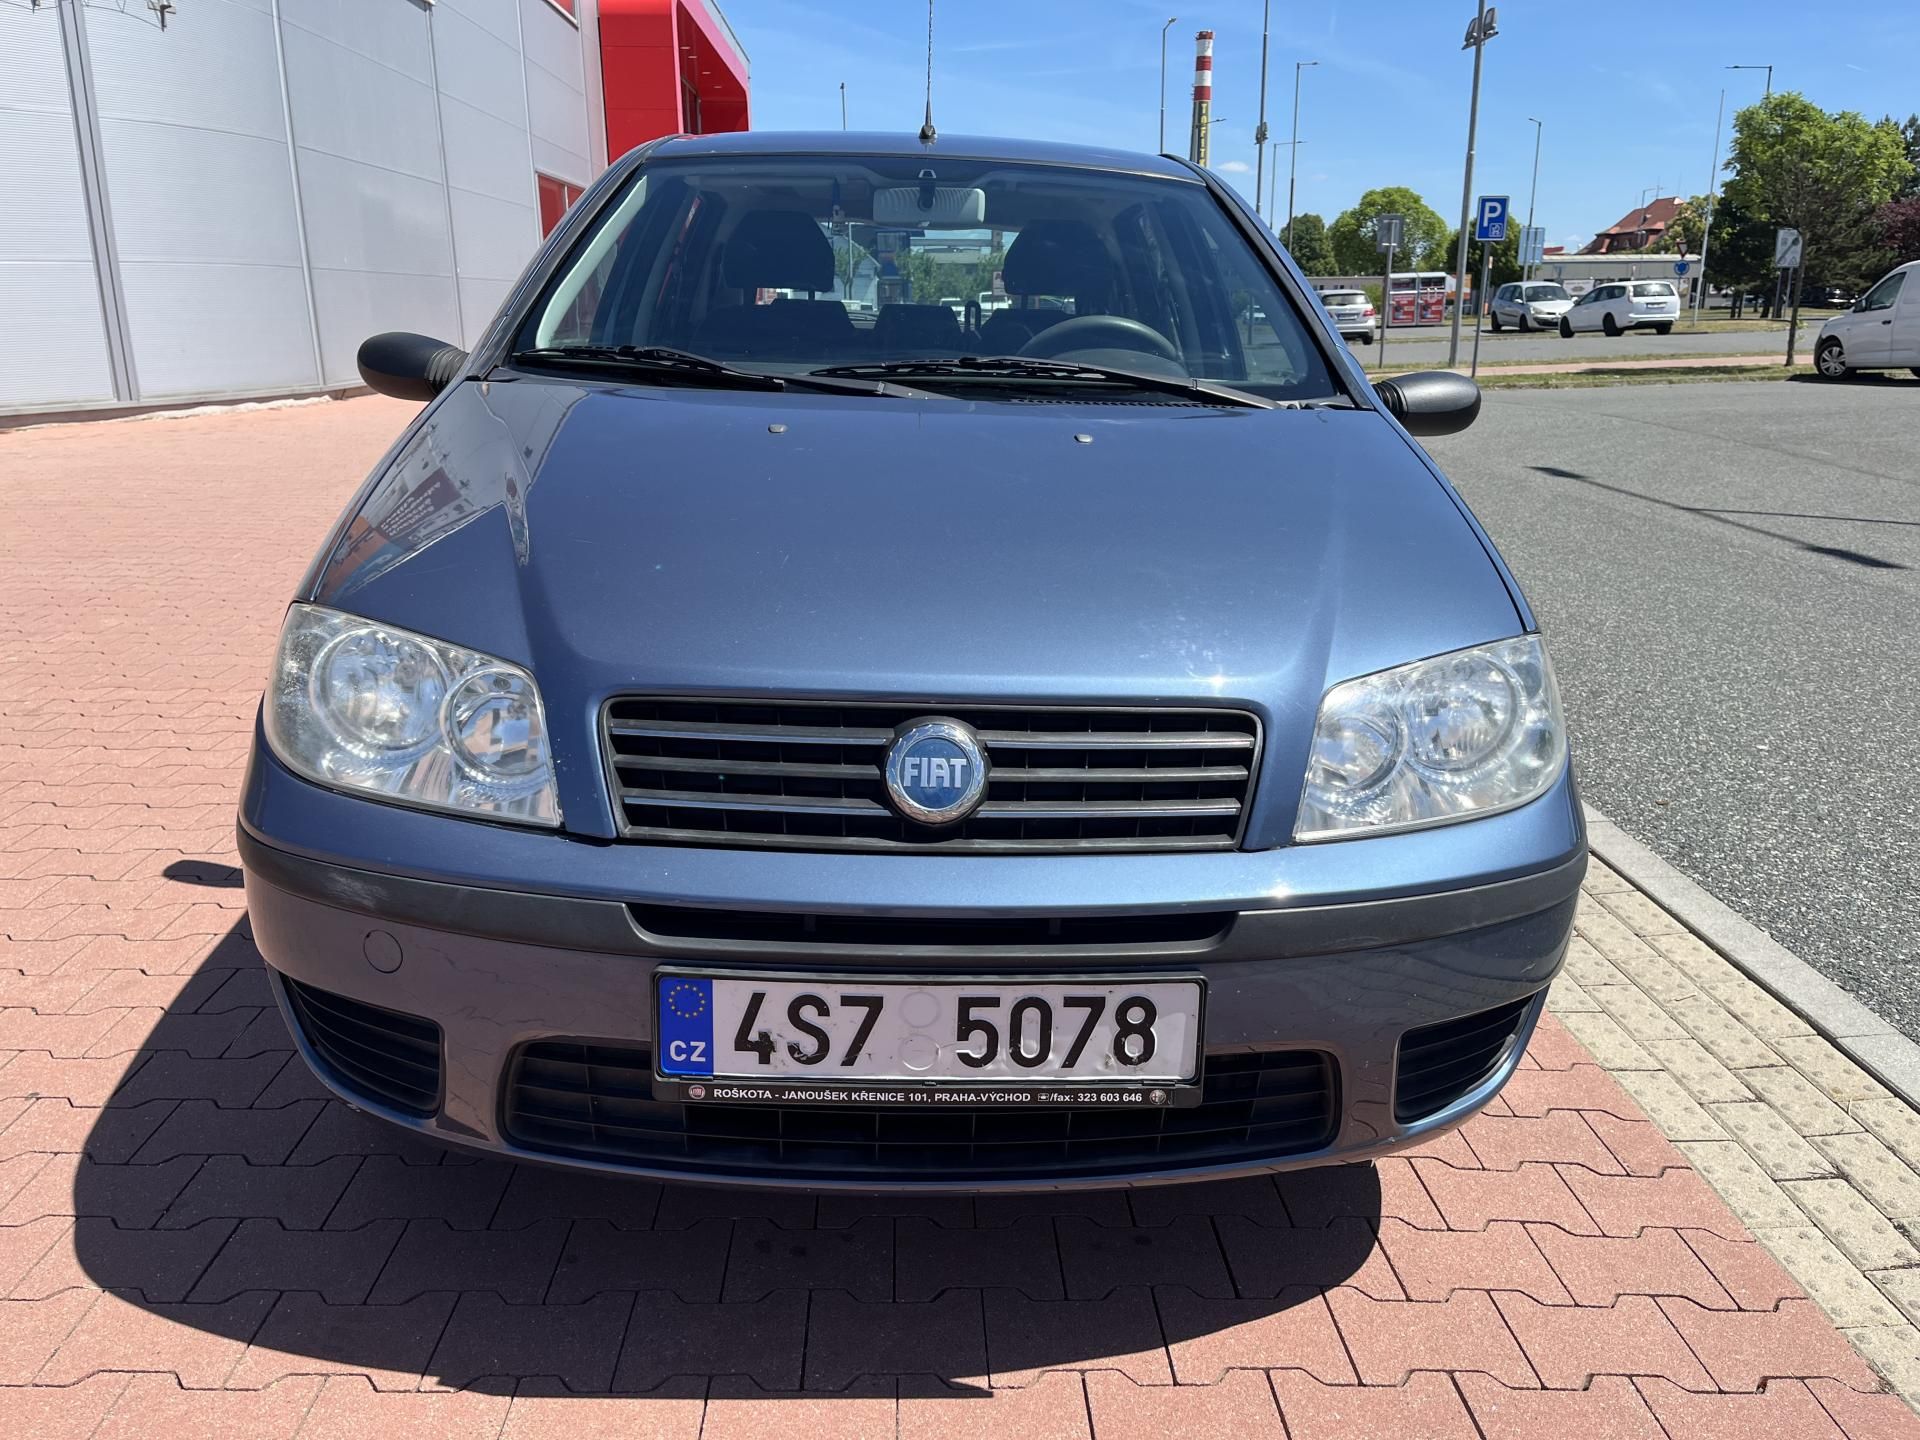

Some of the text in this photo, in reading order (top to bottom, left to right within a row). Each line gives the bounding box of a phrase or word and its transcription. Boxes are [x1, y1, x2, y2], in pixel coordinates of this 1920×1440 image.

[1482, 201, 1502, 227] P
[903, 757, 967, 789] FIAT
[734, 991, 1159, 1069] 4S7 5078
[669, 1040, 707, 1062] CZ
[713, 1087, 772, 1099] ROŠKOTA
[781, 1089, 849, 1101] JANOUŠEK
[851, 1090, 905, 1102] KŘENICE
[908, 1093, 931, 1103] 101,
[934, 1091, 1031, 1103] PRAHA-VÝCHOD
[1077, 1093, 1097, 1102] 323
[1100, 1093, 1120, 1102] 603
[1122, 1093, 1142, 1102] 646
